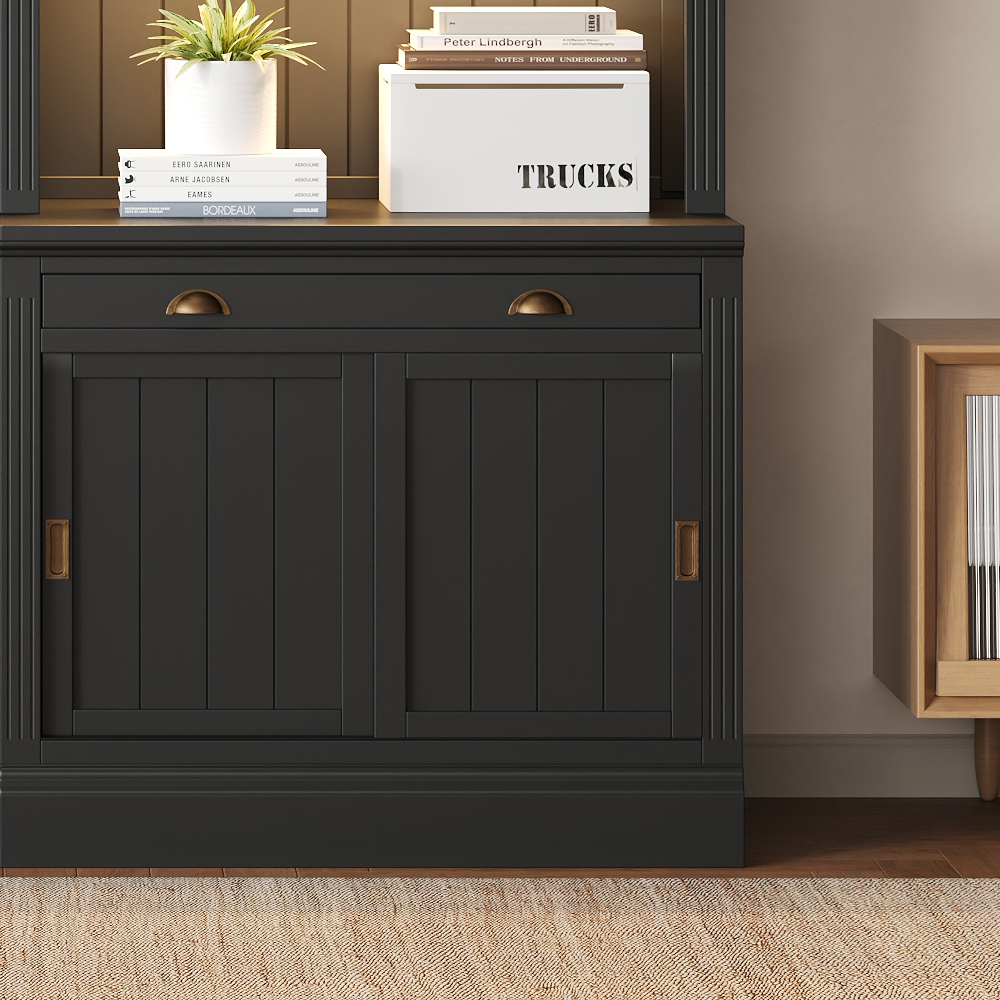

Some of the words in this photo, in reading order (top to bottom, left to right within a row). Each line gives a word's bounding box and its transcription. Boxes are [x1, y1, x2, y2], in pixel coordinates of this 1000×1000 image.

[444, 38, 476, 47] Peter
[479, 38, 542, 48] Lindbergh
[517, 163, 634, 189] TRUCKS
[202, 205, 256, 216] BORDEAUX
